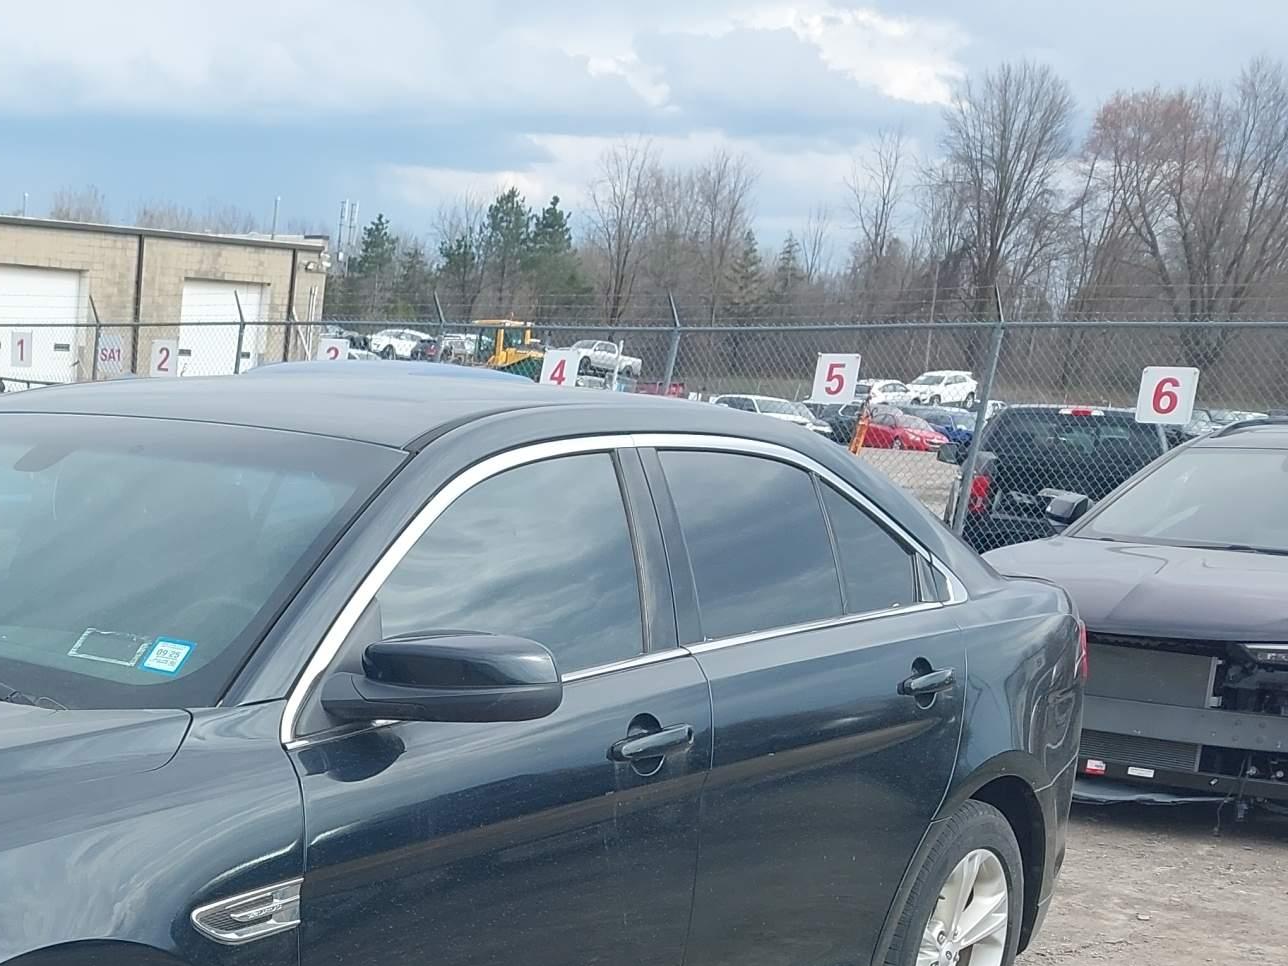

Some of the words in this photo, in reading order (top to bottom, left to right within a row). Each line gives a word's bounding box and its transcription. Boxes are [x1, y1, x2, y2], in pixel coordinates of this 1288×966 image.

[17, 339, 24, 361] 1
[100, 347, 121, 361] SA1
[158, 347, 170, 372] 2
[550, 359, 566, 385] 4
[825, 363, 846, 395] 5
[1153, 377, 1180, 414] 6
